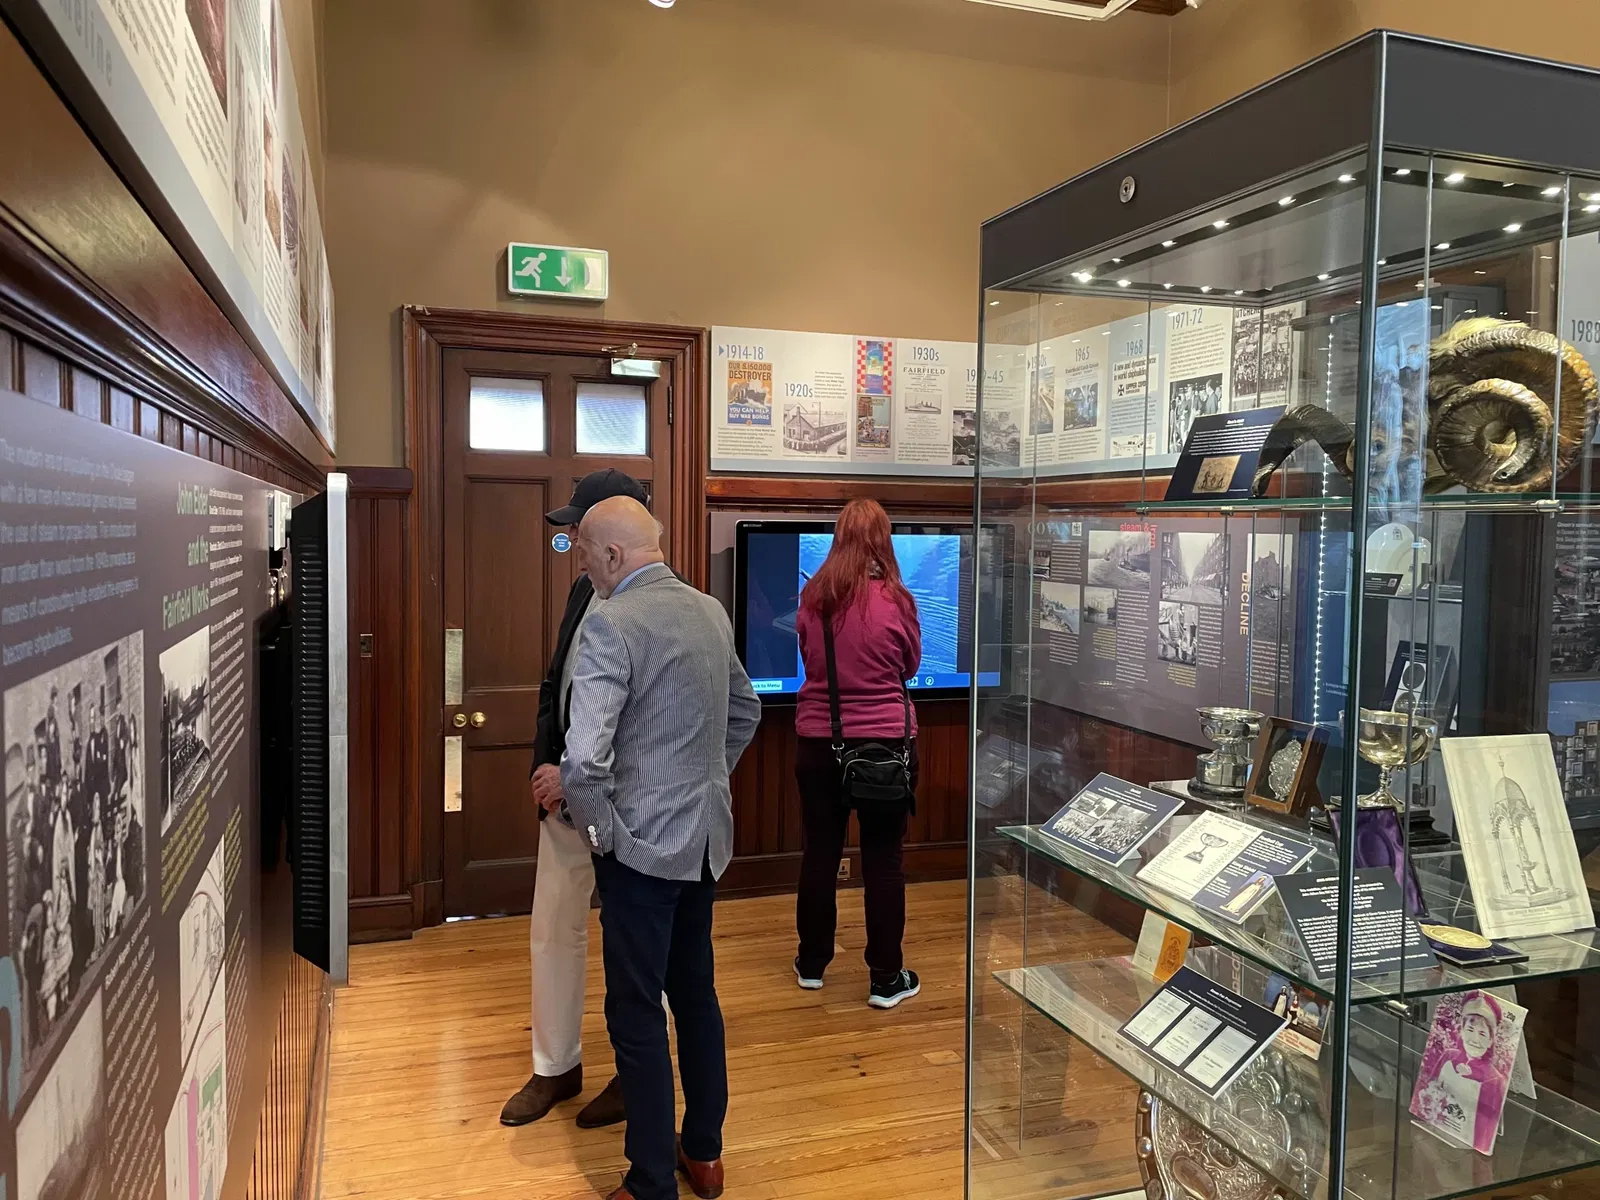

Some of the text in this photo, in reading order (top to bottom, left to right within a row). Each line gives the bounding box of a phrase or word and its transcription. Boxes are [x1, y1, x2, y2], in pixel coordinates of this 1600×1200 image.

[726, 344, 764, 360] 1914-18
[913, 347, 940, 361] 1930s
[1075, 346, 1090, 361] 1965
[1126, 339, 1143, 356] 1968
[729, 371, 772, 381] DESTROYER
[903, 366, 946, 375] FAIRFIELD
[785, 383, 813, 398] 1920s
[177, 481, 208, 515] John Elder
[1120, 522, 1141, 532] steam
[188, 534, 208, 567] and the
[163, 583, 209, 631] Fairfield Works
[1240, 572, 1250, 636] DECLINE
